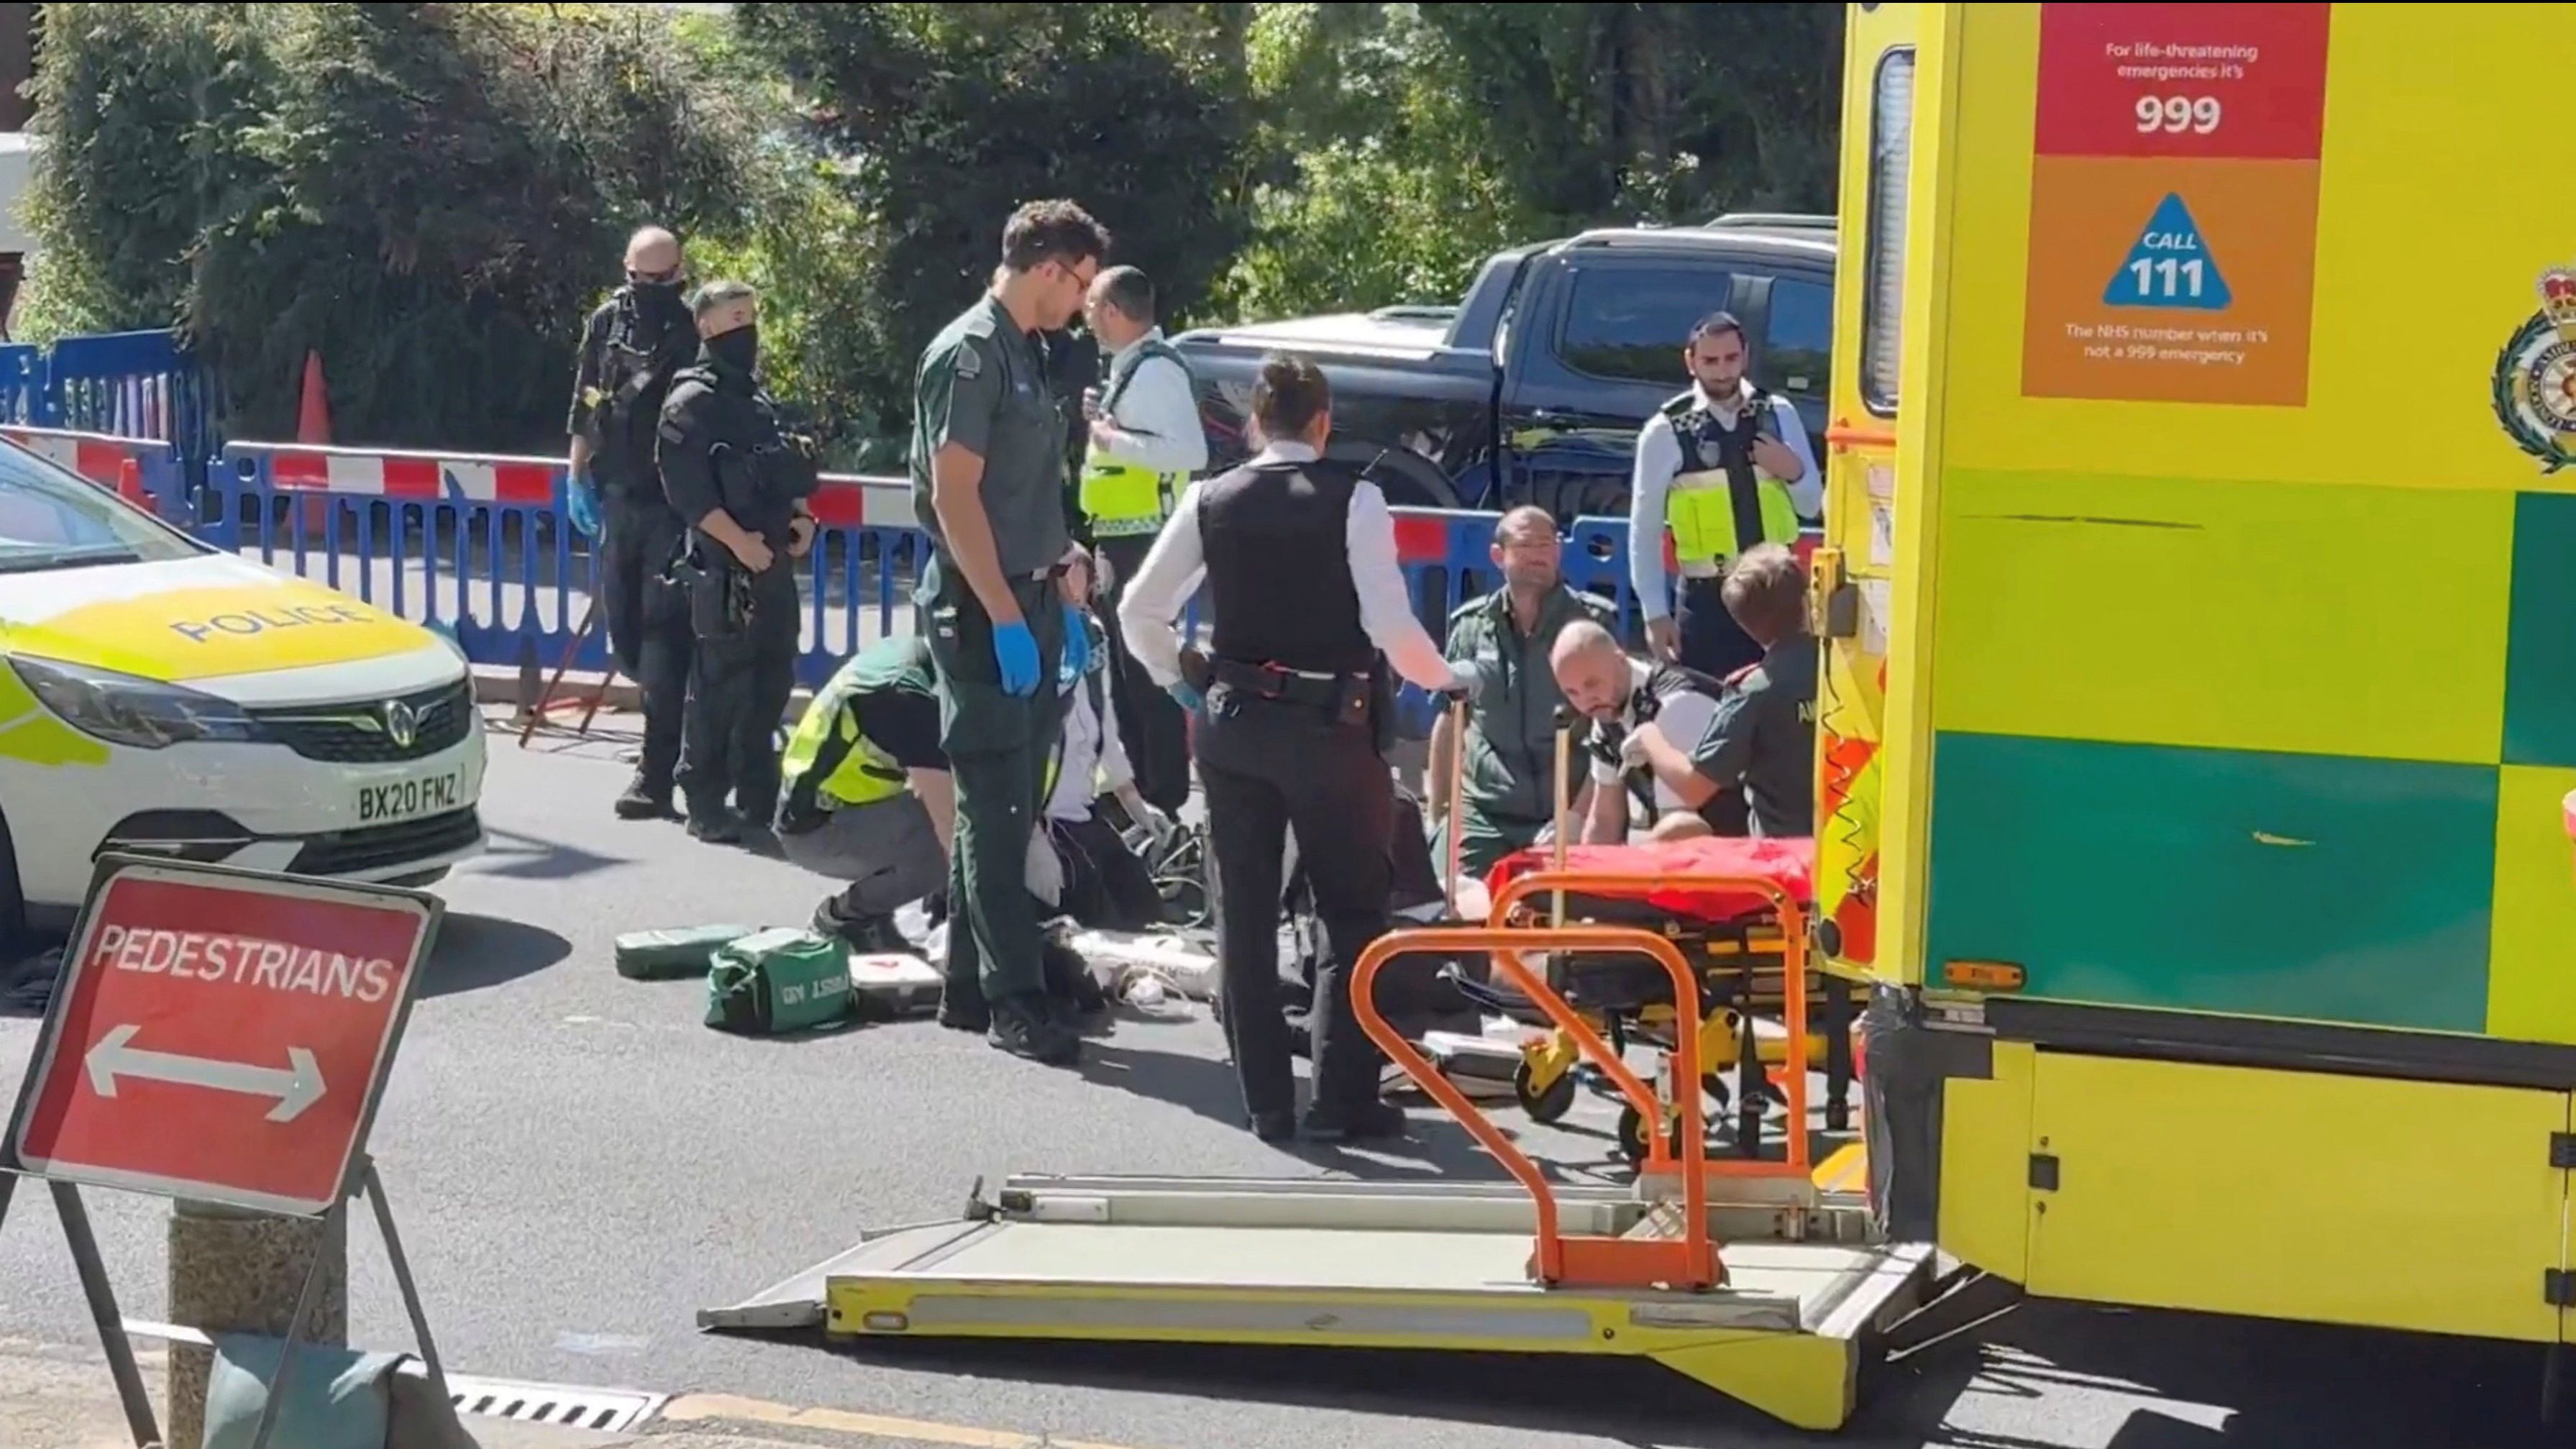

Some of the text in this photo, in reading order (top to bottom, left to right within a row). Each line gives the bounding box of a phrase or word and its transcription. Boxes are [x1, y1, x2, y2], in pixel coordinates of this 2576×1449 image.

[2106, 42, 2259, 63] For life-threatening
[2117, 63, 2244, 81] emergencies it's
[2135, 94, 2221, 134] 999
[2143, 231, 2198, 250] CALL
[2129, 257, 2203, 297] 111
[2065, 324, 2268, 343] The NHS number when it's
[2084, 345, 2246, 365] not a 999 emergency
[170, 605, 374, 642] POLICE
[360, 780, 418, 821] BX20
[92, 924, 394, 1002] PEDESTRIANS
